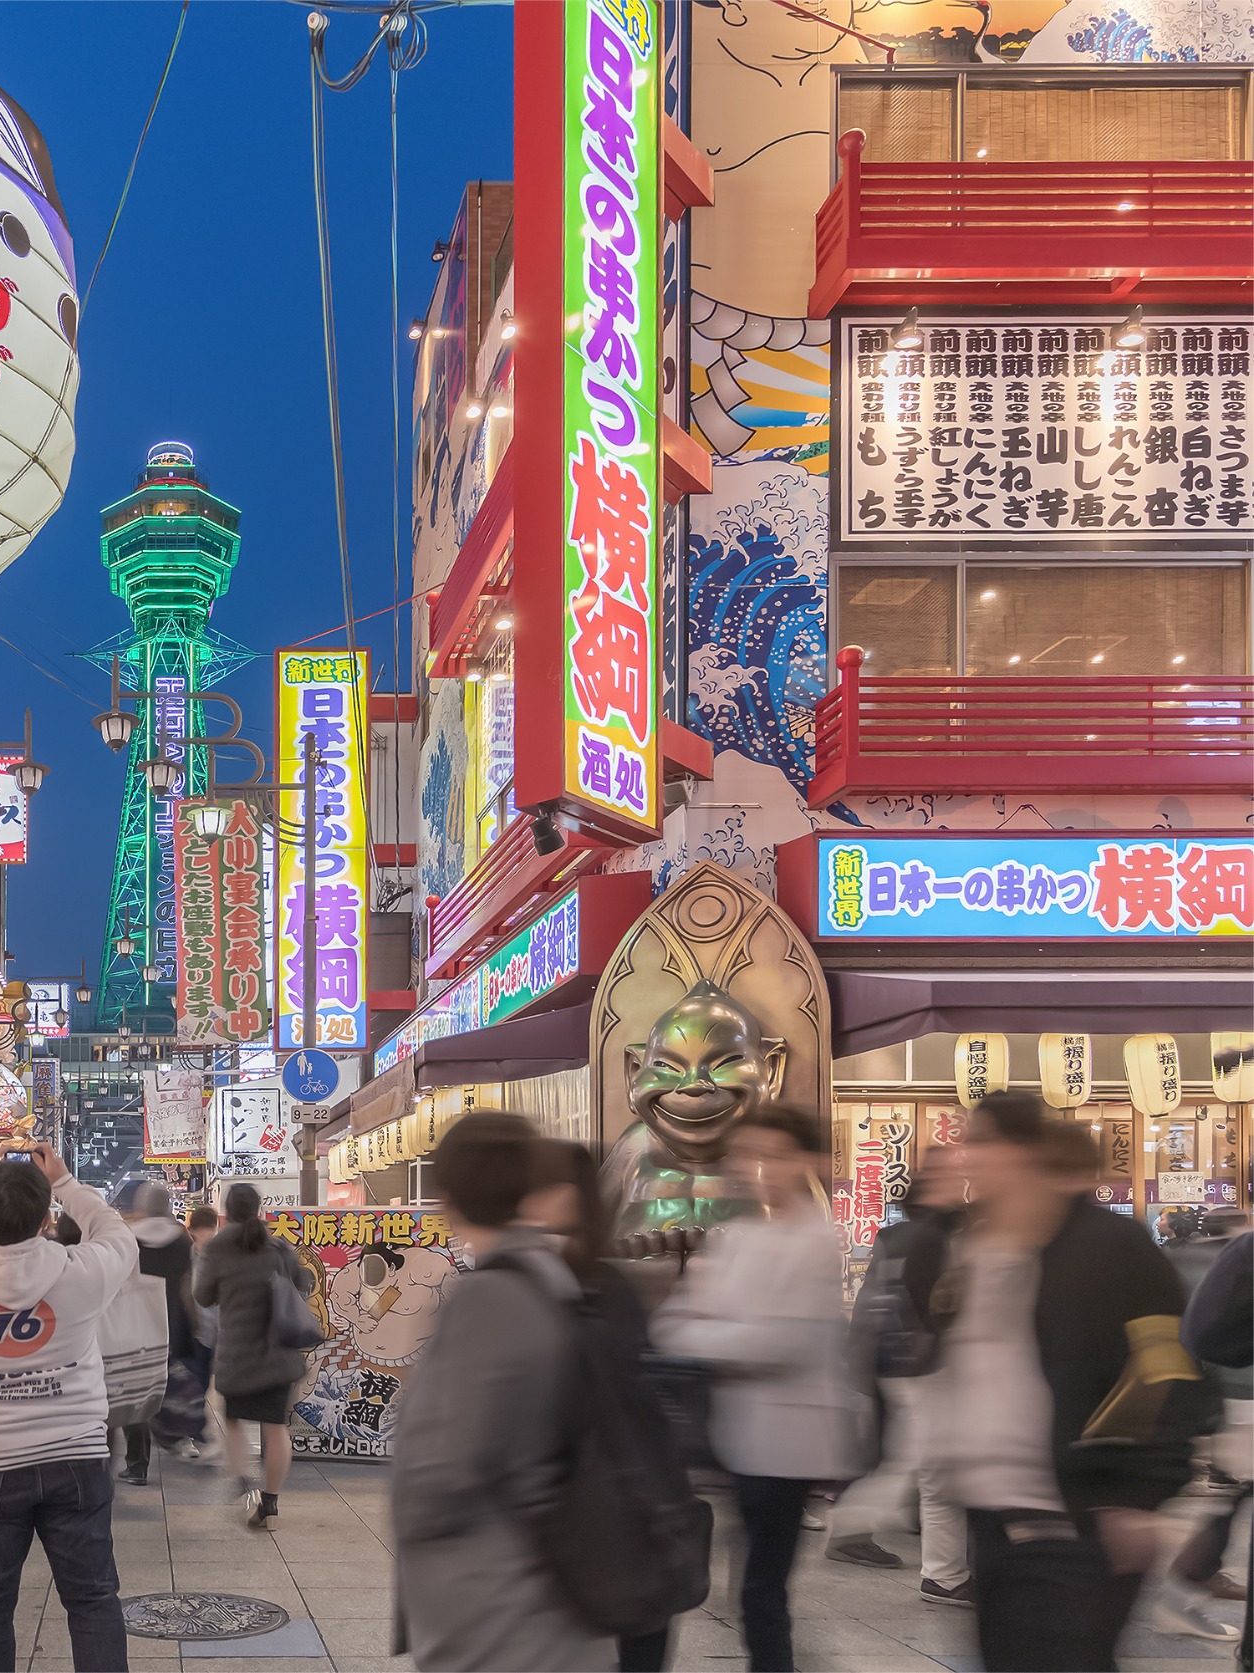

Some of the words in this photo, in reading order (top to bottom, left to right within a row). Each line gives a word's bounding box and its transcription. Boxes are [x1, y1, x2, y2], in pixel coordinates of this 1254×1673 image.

[585, 8, 637, 448] 日本一の串かつ
[857, 328, 889, 378] 前頭
[929, 328, 962, 378] 前頭
[965, 328, 998, 378] 前頭
[1001, 328, 1034, 378] 前頭
[1037, 328, 1070, 377] 前頭
[1073, 328, 1106, 377] 前頭
[1146, 328, 1178, 377] 前頭
[1182, 328, 1214, 377] 前頭
[1217, 328, 1251, 377] 前頭
[857, 426, 887, 528] もち
[892, 426, 929, 528] うずら玉子
[928, 426, 963, 528] 紅しょうが
[963, 426, 997, 528] にんにく
[999, 426, 1035, 528] 玉ねぎ
[1035, 426, 1069, 528] 山芋
[1070, 426, 1107, 528] しし唐
[1107, 426, 1142, 528] れんこん
[1143, 426, 1179, 528] 銀杏
[1180, 426, 1216, 528] 白ねぎ
[1216, 426, 1250, 528] さつま芋
[570, 438, 650, 745] 横綱
[285, 658, 358, 683] 新世界
[582, 731, 644, 811] 酒処
[833, 849, 864, 928] 新世界
[868, 864, 1088, 912] 日本一の串かつ
[1093, 846, 1254, 930] 横綱
[529, 905, 566, 993] 横綱
[967, 1040, 988, 1099] 自慢の逸品
[1064, 1046, 1085, 1096] 握り盛り
[1159, 1052, 1178, 1102] 握り盛り
[294, 1109, 328, 1119] 9-22
[1112, 1123, 1130, 1174] にんにく
[854, 1140, 885, 1245] 二度漬け
[886, 1123, 912, 1198] ソースの
[268, 1213, 454, 1247] 大阪新世界
[339, 1367, 402, 1433] 横綱
